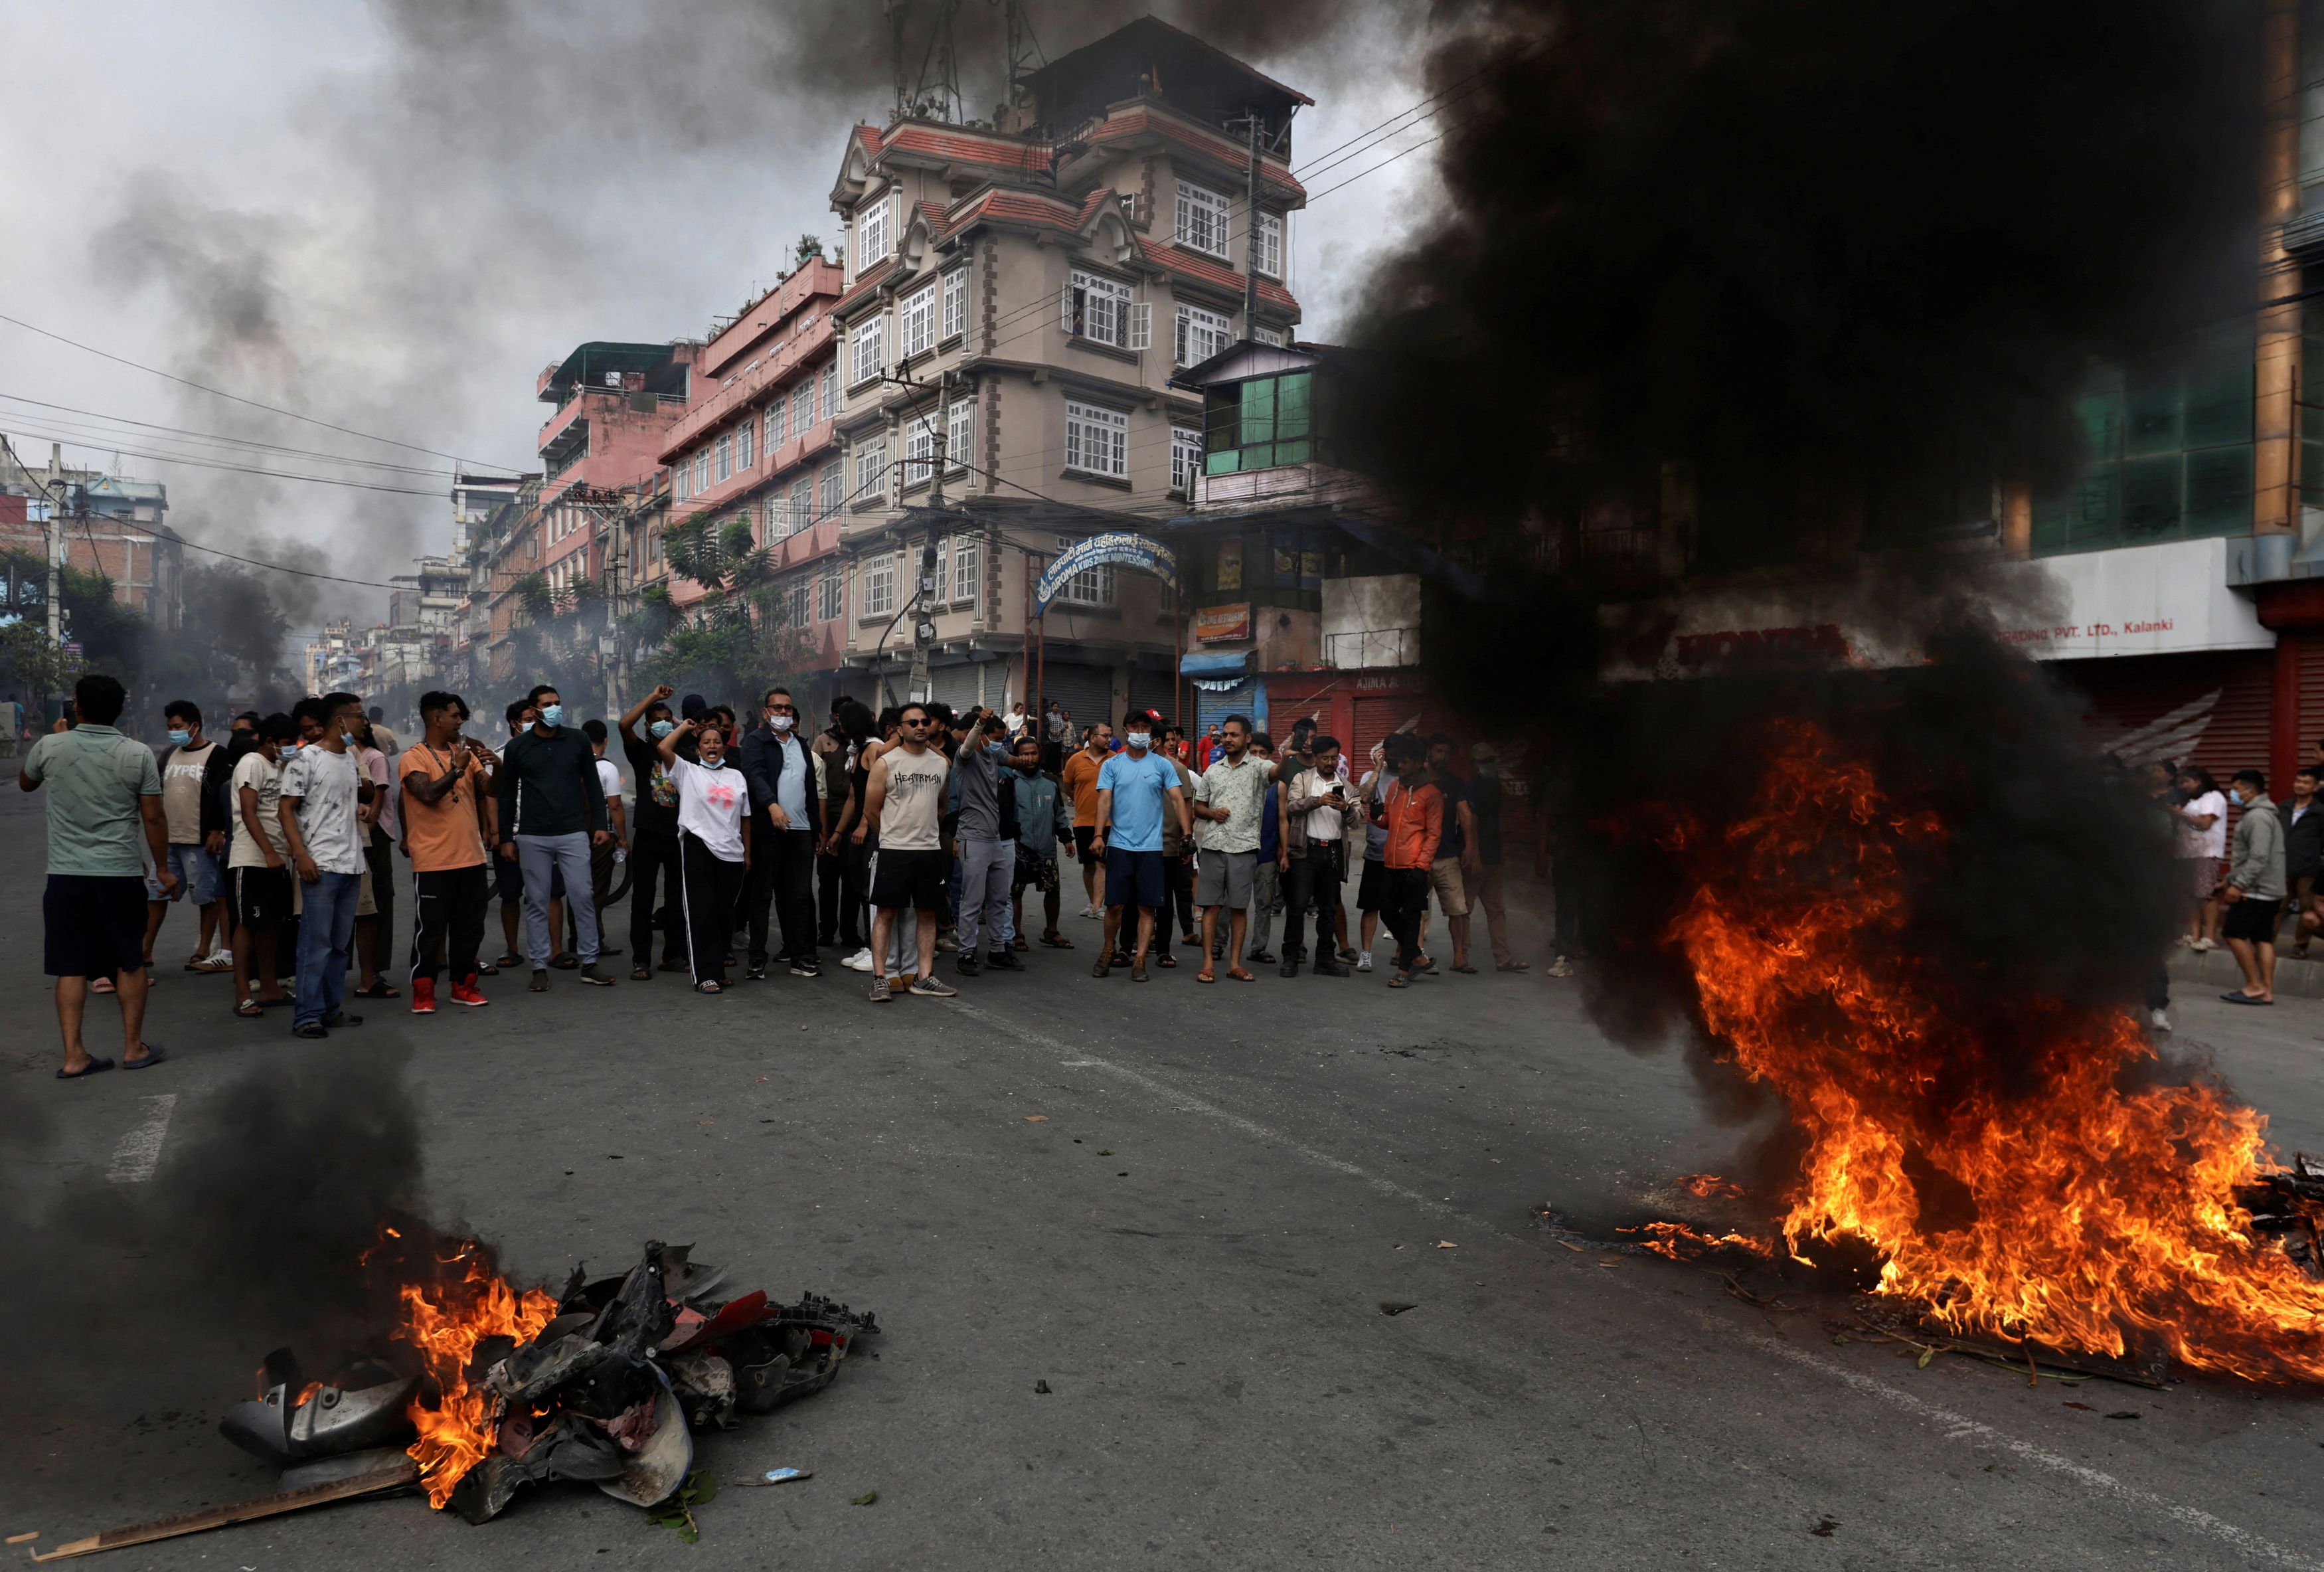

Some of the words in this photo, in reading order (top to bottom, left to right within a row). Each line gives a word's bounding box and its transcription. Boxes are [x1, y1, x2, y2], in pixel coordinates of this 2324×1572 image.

[1075, 537, 1093, 555] मार्ग
[1051, 563, 1078, 594] AROMA
[1078, 557, 1094, 572] KIDS
[2054, 626, 2081, 638] PVT.
[2124, 618, 2174, 634] Kalanki
[894, 770, 942, 786] HEATRMAN
